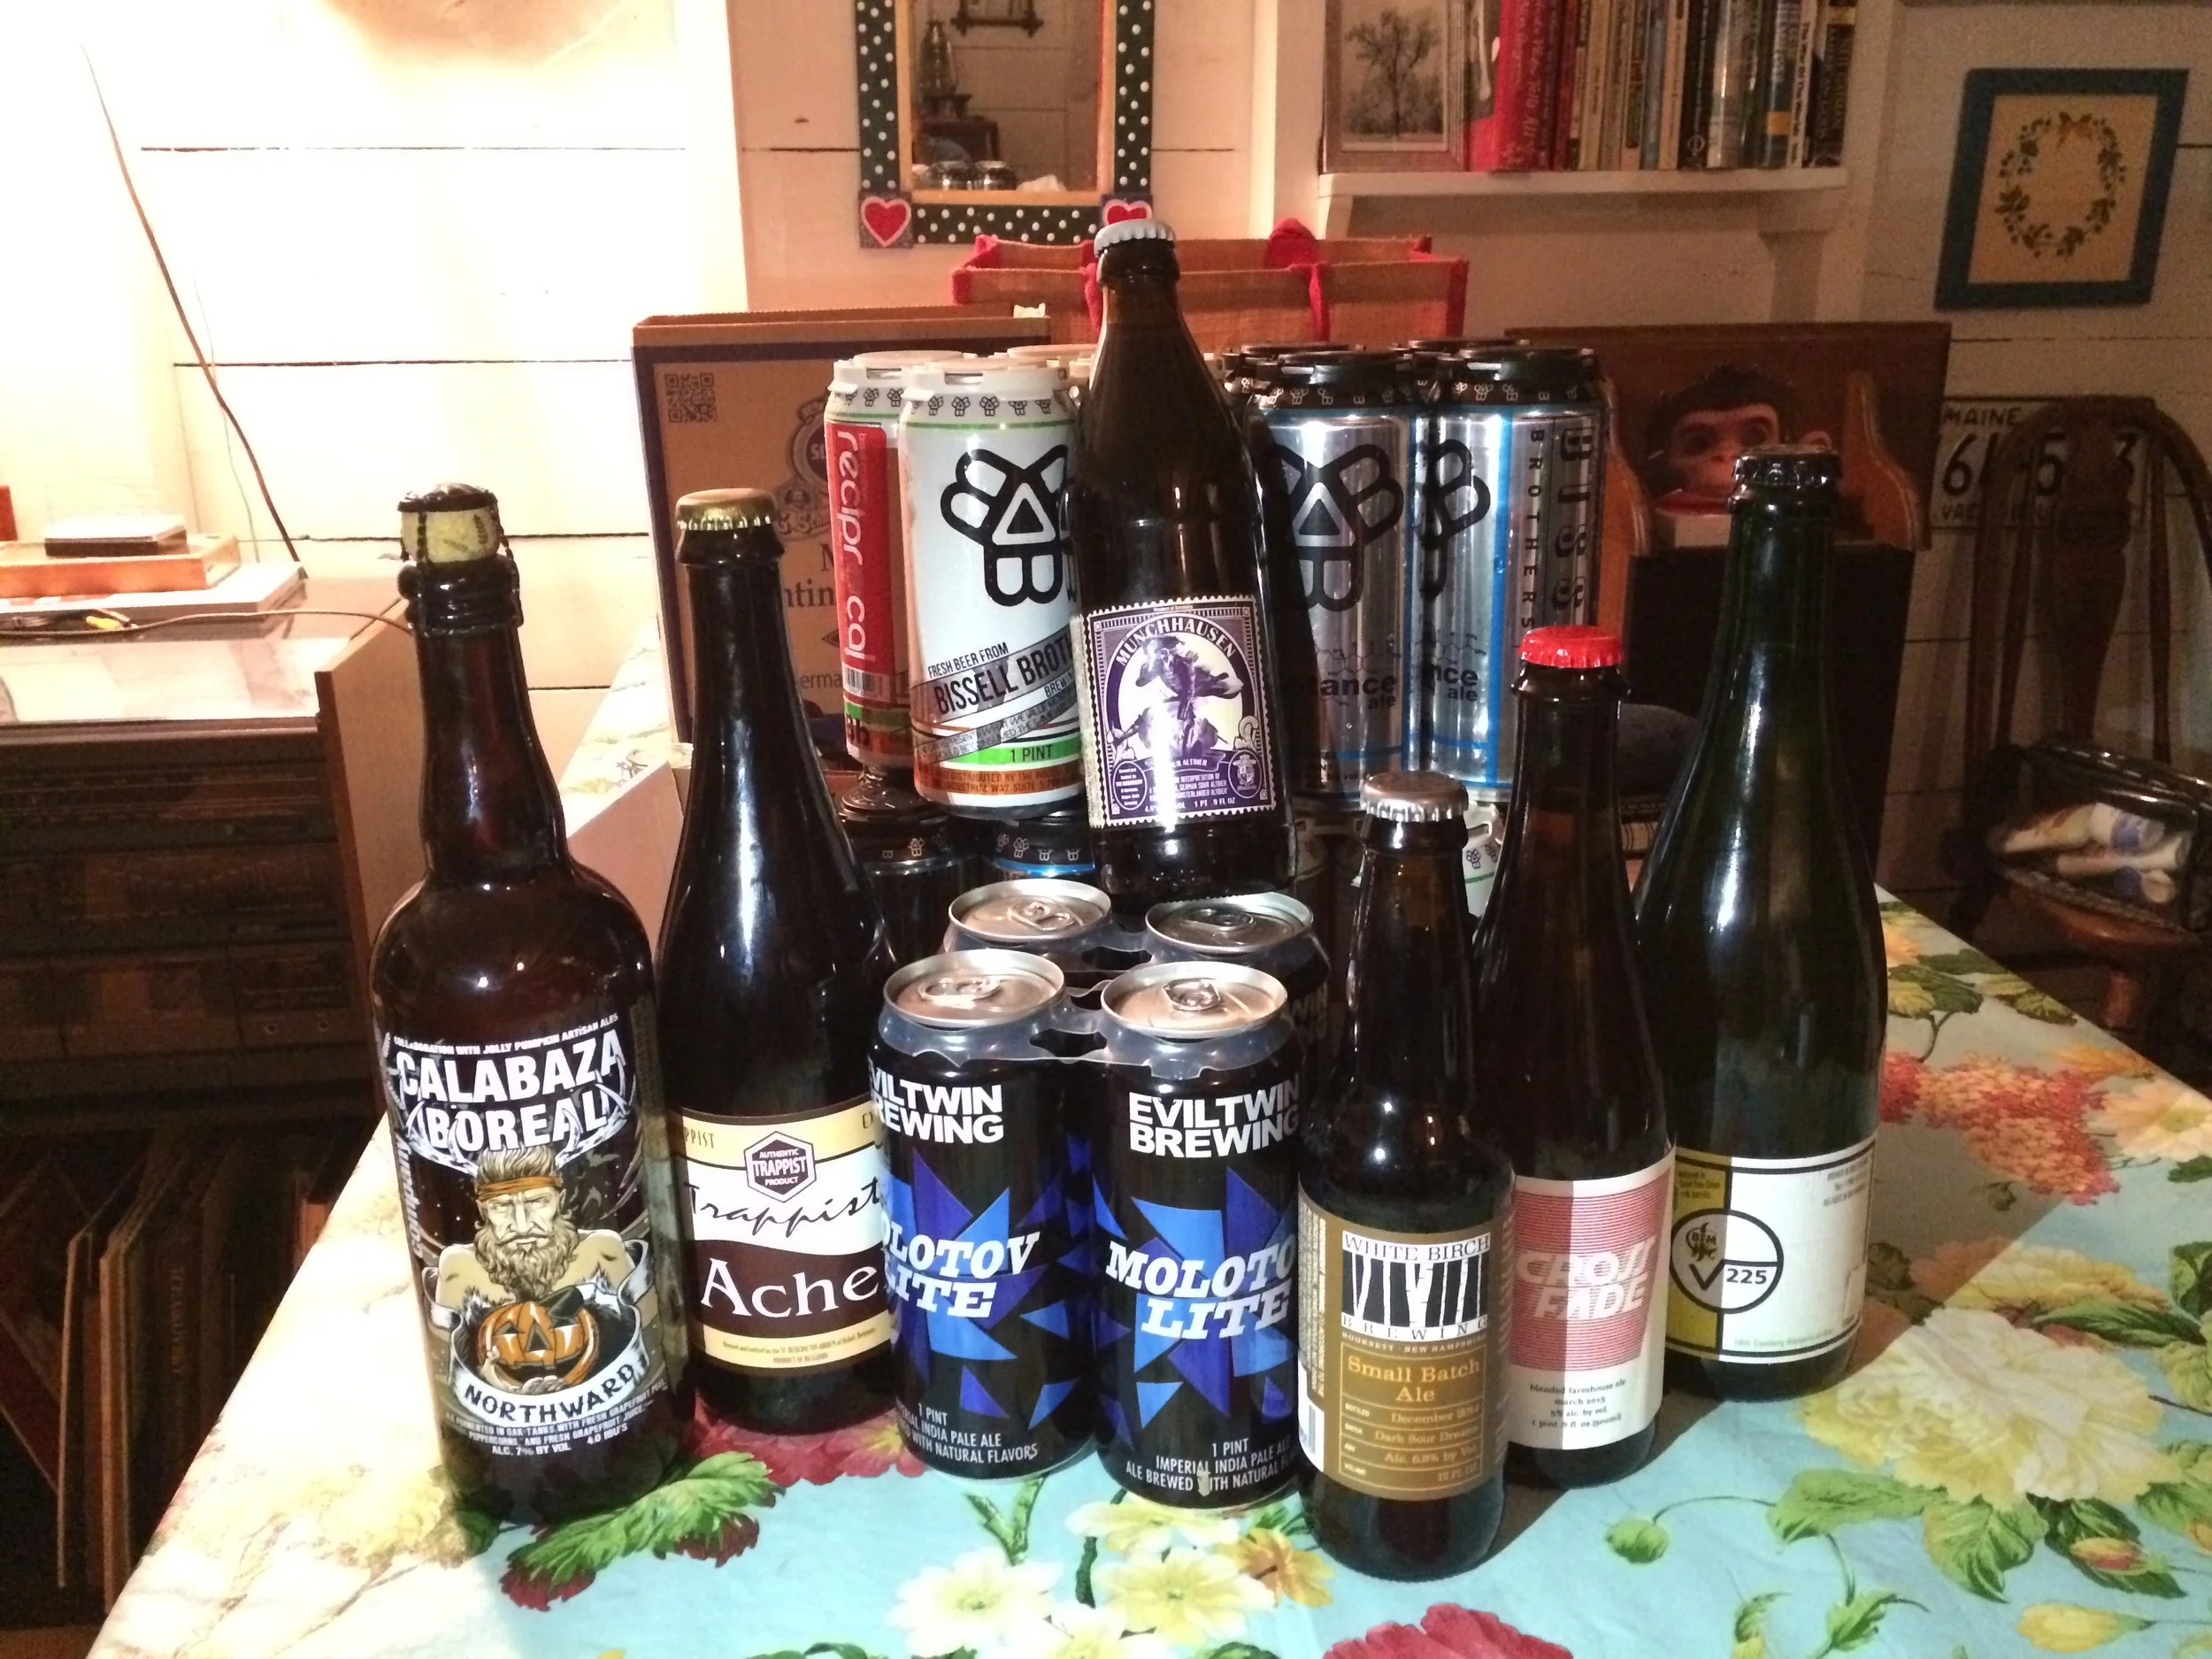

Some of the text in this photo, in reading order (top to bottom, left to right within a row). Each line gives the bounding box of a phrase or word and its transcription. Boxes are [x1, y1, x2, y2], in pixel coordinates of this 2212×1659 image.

[1945, 407, 2022, 426] MAINE
[1521, 429, 1545, 629] BROTHERS
[784, 579, 835, 608] ntin
[928, 641, 1010, 679] FRESH BEER FROM
[800, 672, 841, 689] erma
[1044, 669, 1076, 698] BREWIN
[1319, 675, 1397, 696] ance
[1431, 664, 1479, 687] nce
[933, 664, 1019, 715] BISSELL
[1447, 687, 1479, 702] ale
[1368, 694, 1396, 710] ale
[1010, 745, 1053, 763] 1 PINT
[456, 1045, 480, 1056] WITH
[483, 1042, 513, 1056] JOLLY
[515, 1033, 560, 1051] PUMPKIN
[600, 1012, 619, 1029] ALES
[396, 1028, 626, 1103] CALABAZA
[869, 1064, 1003, 1115] VILTWIN
[871, 1091, 1004, 1144] REWING
[684, 1127, 715, 1148] PPIST
[1129, 1103, 1300, 1158] BREWING
[759, 1148, 799, 1159] AUTHENTIC
[752, 1156, 807, 1178] TRAPPIST
[764, 1176, 799, 1187] PRODUCT
[887, 1221, 1041, 1279] LOTOV
[1344, 1233, 1491, 1261] WHITE BIRCH
[1105, 1233, 1296, 1298] MOLOTO
[1725, 1268, 1768, 1286] 225
[700, 1257, 879, 1318] Ache
[1141, 1279, 1292, 1340] LITE
[1343, 1315, 1487, 1341] BREWING
[1403, 1344, 1427, 1354] NEW
[1432, 1333, 1487, 1353] HAMPSHIRE
[1347, 1355, 1481, 1384] Small Batch
[464, 1363, 635, 1424] NORTHWARD
[1395, 1386, 1436, 1402] Ale
[1530, 1379, 1626, 1394] blended farmhouse ale
[495, 1426, 505, 1436] IN
[506, 1426, 524, 1437] OAK
[526, 1425, 556, 1437] TANKS
[557, 1419, 580, 1432] WITH
[581, 1410, 607, 1426] FRESH
[610, 1388, 651, 1417] GRAPEFRUIT
[1554, 1396, 1606, 1407] march 2015
[1582, 1409, 1593, 1418] by
[926, 1406, 949, 1426] PINT
[1391, 1408, 1455, 1424] December
[1539, 1419, 1557, 1429] pint
[524, 1437, 541, 1447] AND
[543, 1432, 571, 1445] FRESH
[572, 1415, 621, 1440] GRAPEFRUIT
[921, 1420, 949, 1443] INDIA
[950, 1430, 978, 1448] PALE
[980, 1432, 1002, 1448] ALE
[1374, 1430, 1405, 1445] Dark
[1408, 1434, 1436, 1445] Sour
[535, 1445, 550, 1455] BY
[912, 1432, 1039, 1464] WITH NATURAL FLAVORS
[1211, 1437, 1250, 1457] 1 PINT
[1443, 1450, 1458, 1463] by
[1156, 1455, 1211, 1476] IMPERIAL
[1215, 1455, 1248, 1474] INDIA
[1250, 1445, 1275, 1467] PALE
[1125, 1460, 1144, 1480] ALE
[1146, 1470, 1194, 1493] BREWED
[1233, 1462, 1279, 1489] NATURAL
